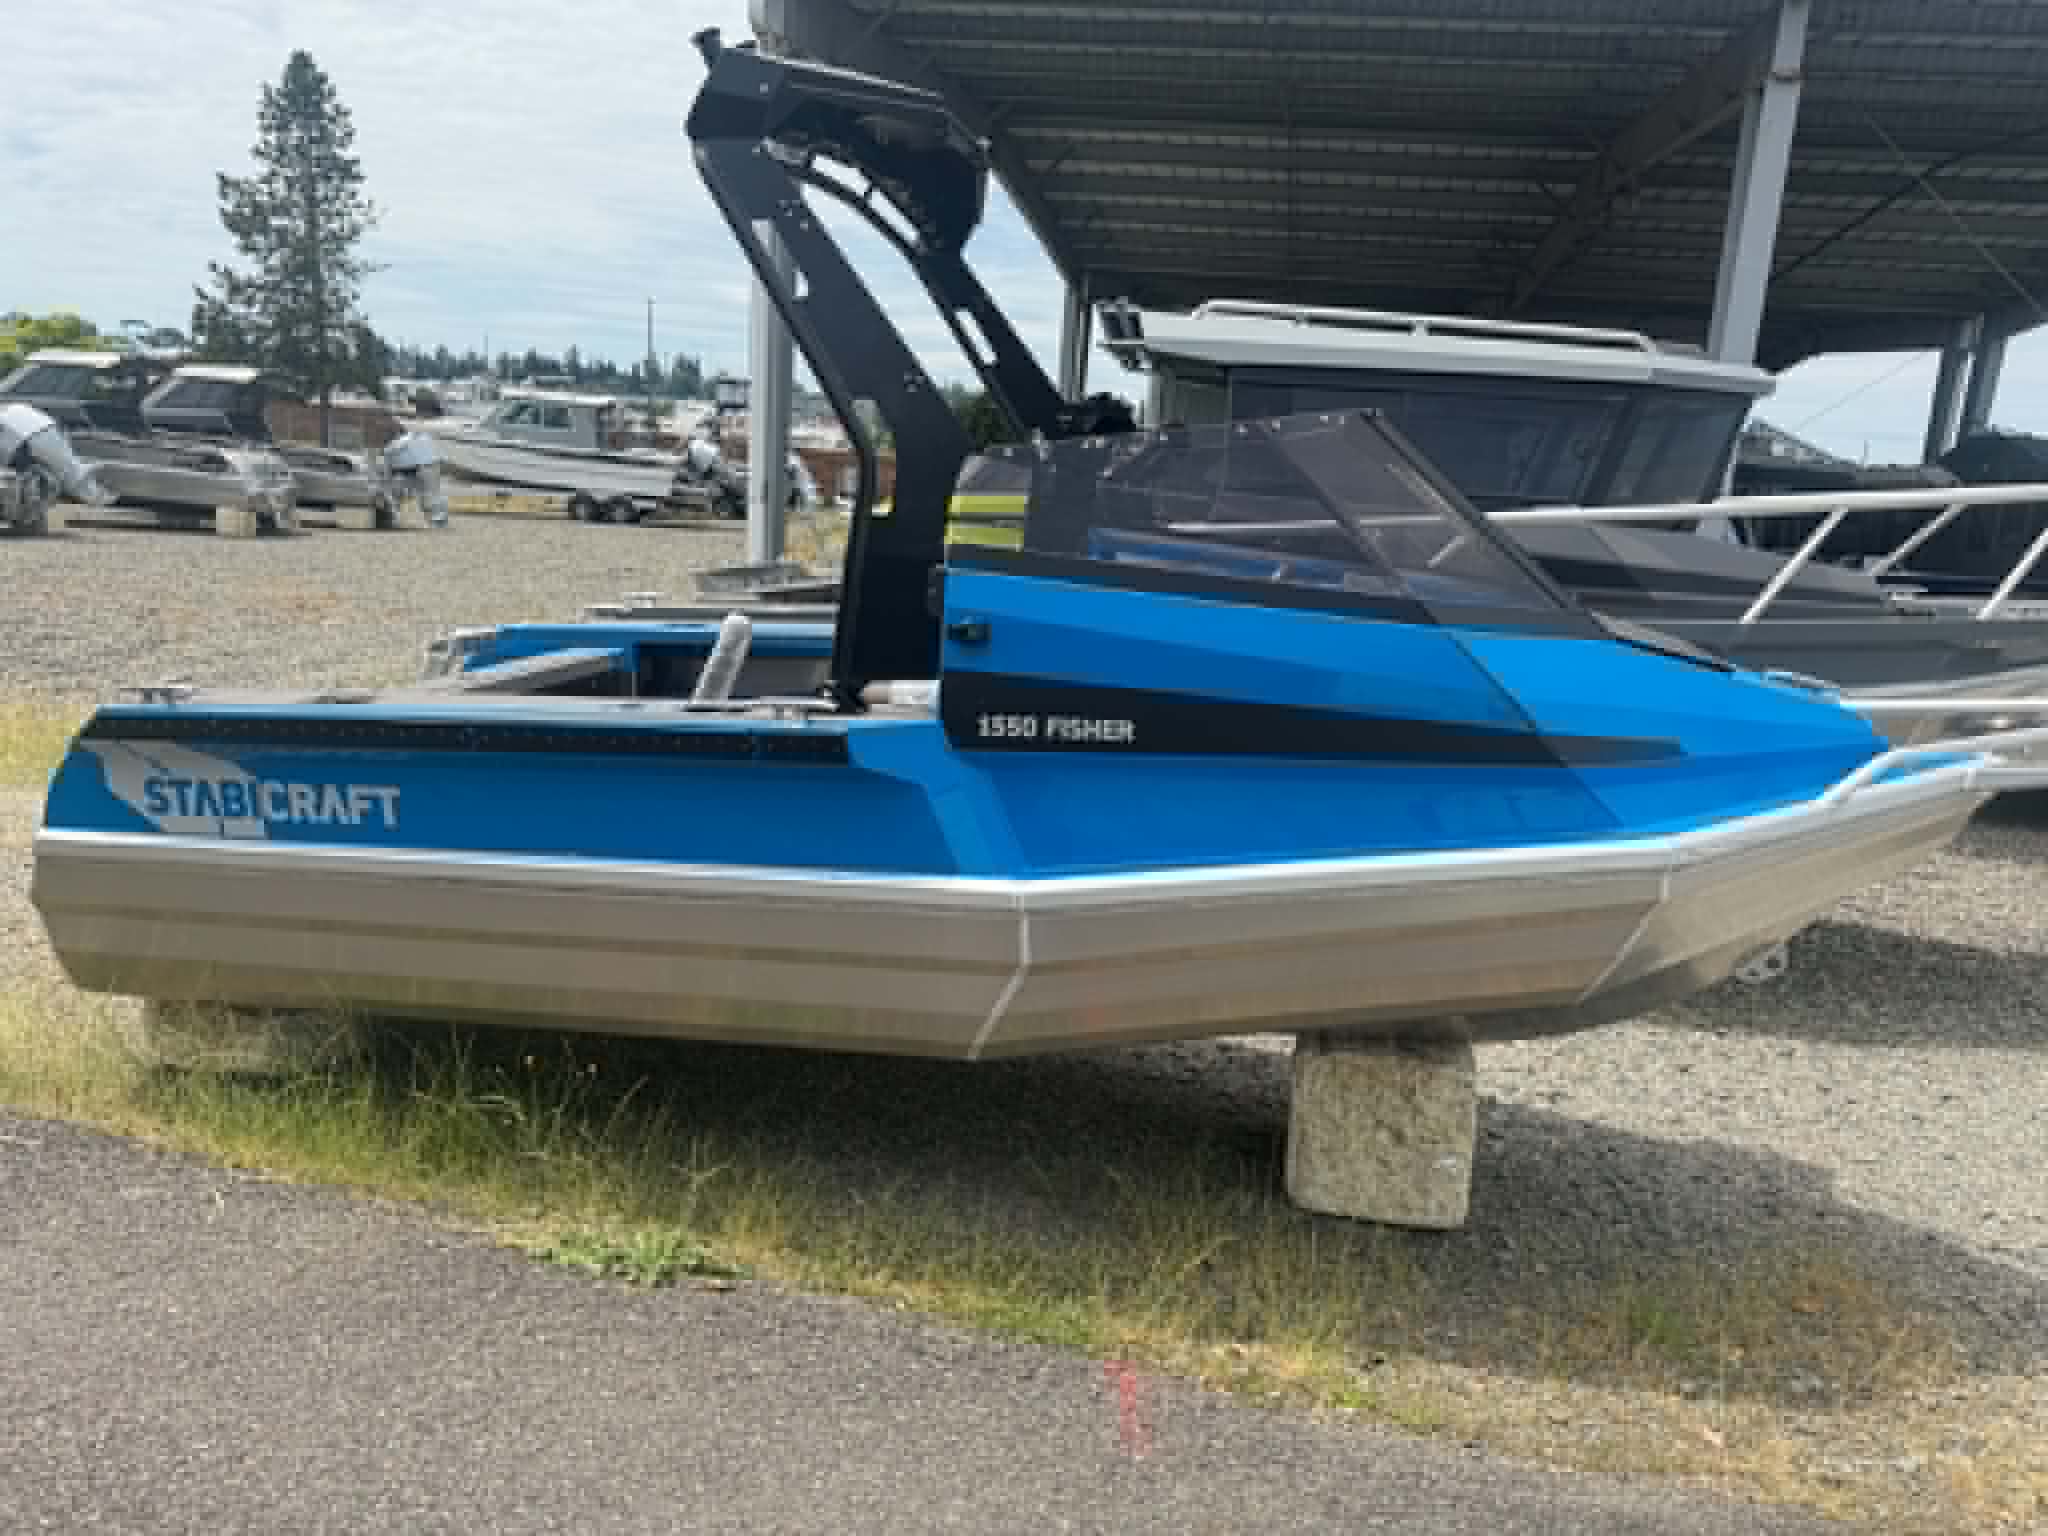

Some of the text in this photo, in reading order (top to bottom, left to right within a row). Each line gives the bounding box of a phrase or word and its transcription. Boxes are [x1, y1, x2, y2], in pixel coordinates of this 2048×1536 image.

[977, 714, 1137, 745] 1550 FISHER
[143, 776, 400, 830] STABICRAFT
